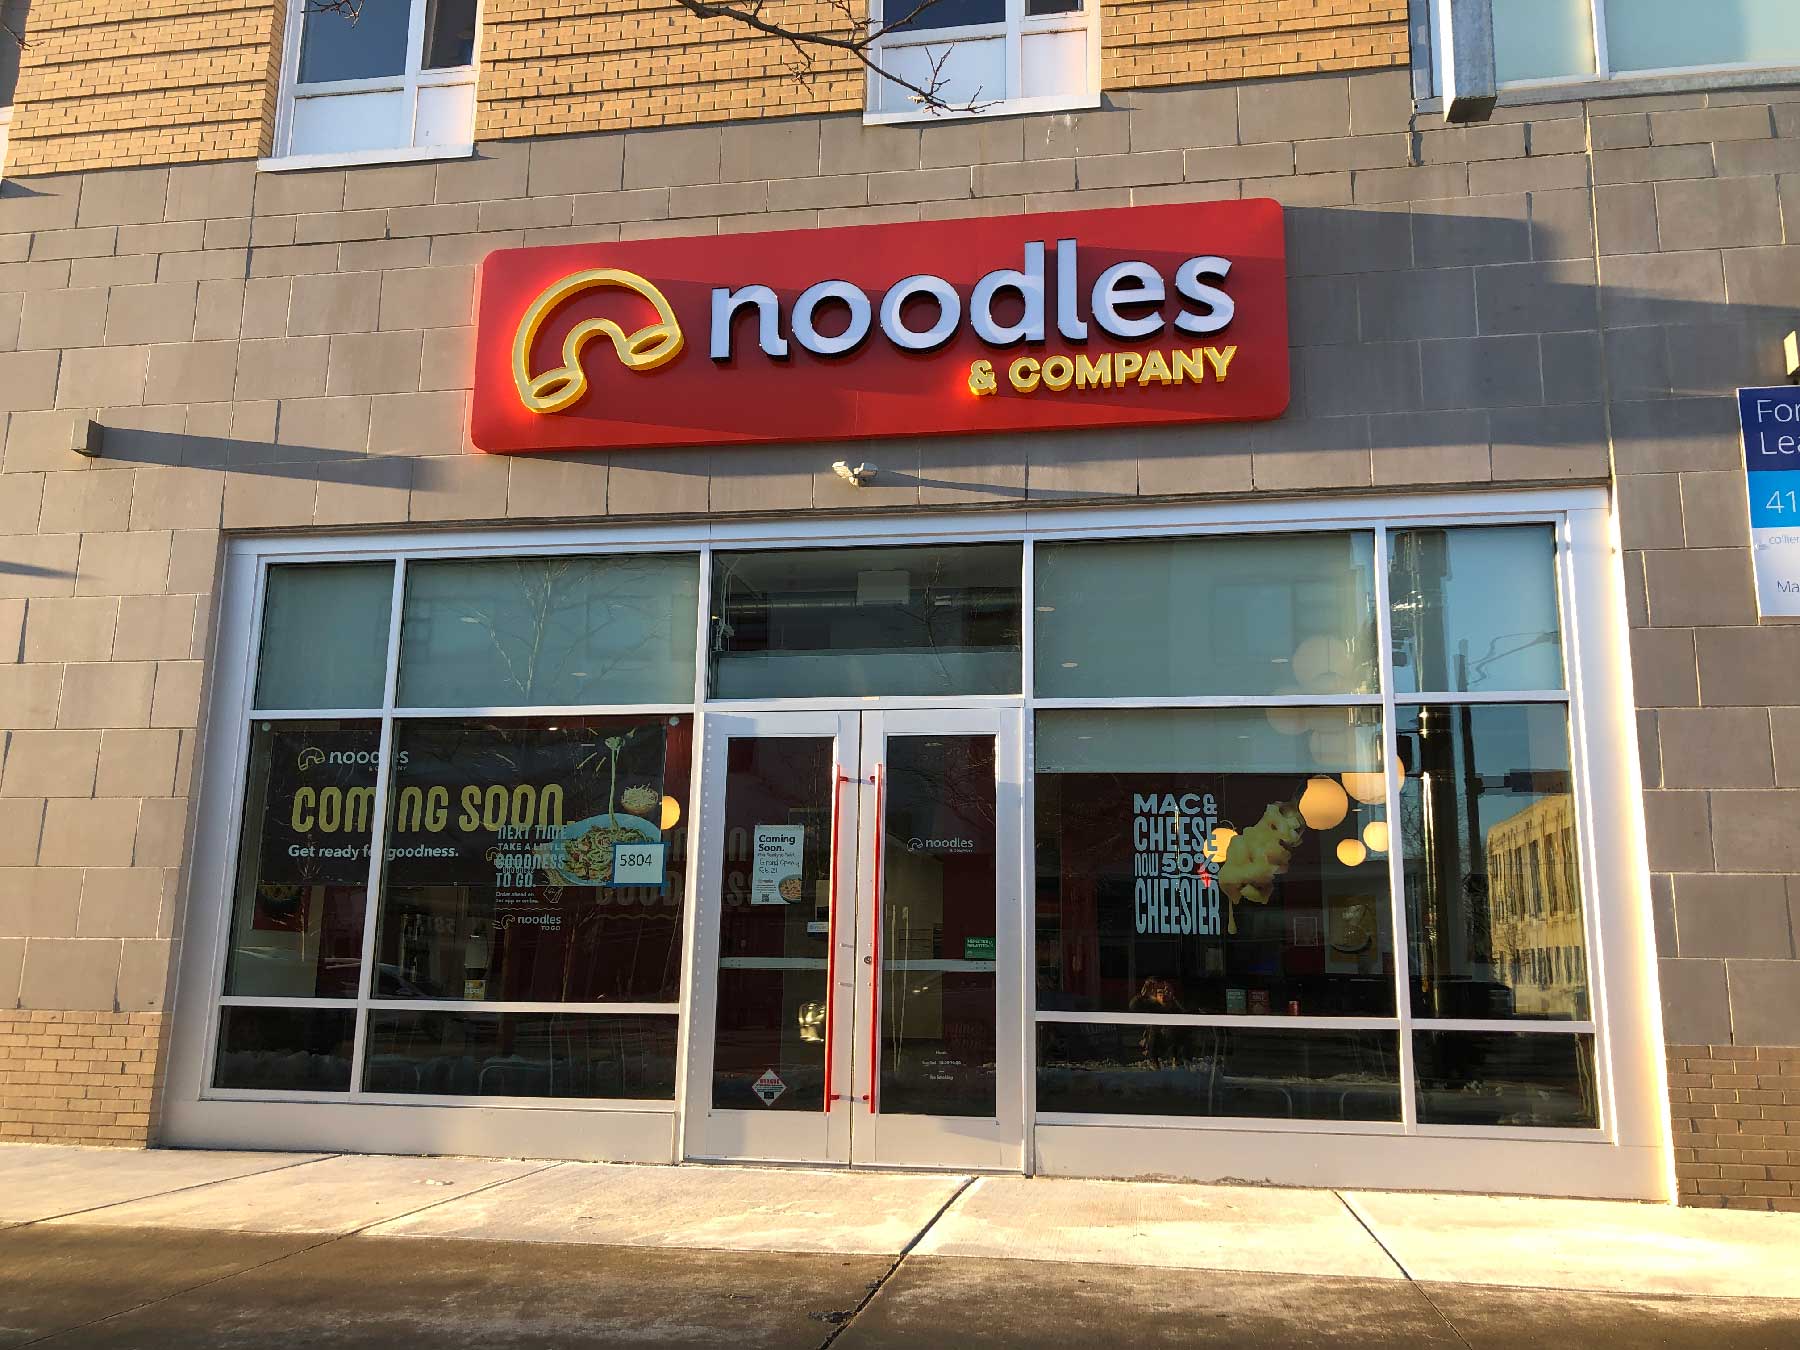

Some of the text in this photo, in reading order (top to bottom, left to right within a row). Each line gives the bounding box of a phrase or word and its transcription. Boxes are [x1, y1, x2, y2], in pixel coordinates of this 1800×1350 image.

[710, 238, 1236, 362] noodles
[968, 345, 1238, 396] & COMPANY
[1761, 431, 1800, 456] Le
[291, 786, 449, 833] COMNG
[925, 837, 974, 848] noodles
[1133, 816, 1218, 852] CHEESE
[288, 844, 315, 857] Get
[319, 844, 360, 861] ready
[389, 844, 459, 861] goodness.
[497, 842, 522, 851] TAKE
[524, 842, 532, 851] A
[619, 853, 653, 867] 5804
[1161, 851, 1220, 874] 50%
[496, 872, 512, 888] TO
[1135, 877, 1220, 935] CHEESIER
[517, 914, 562, 924] noodles
